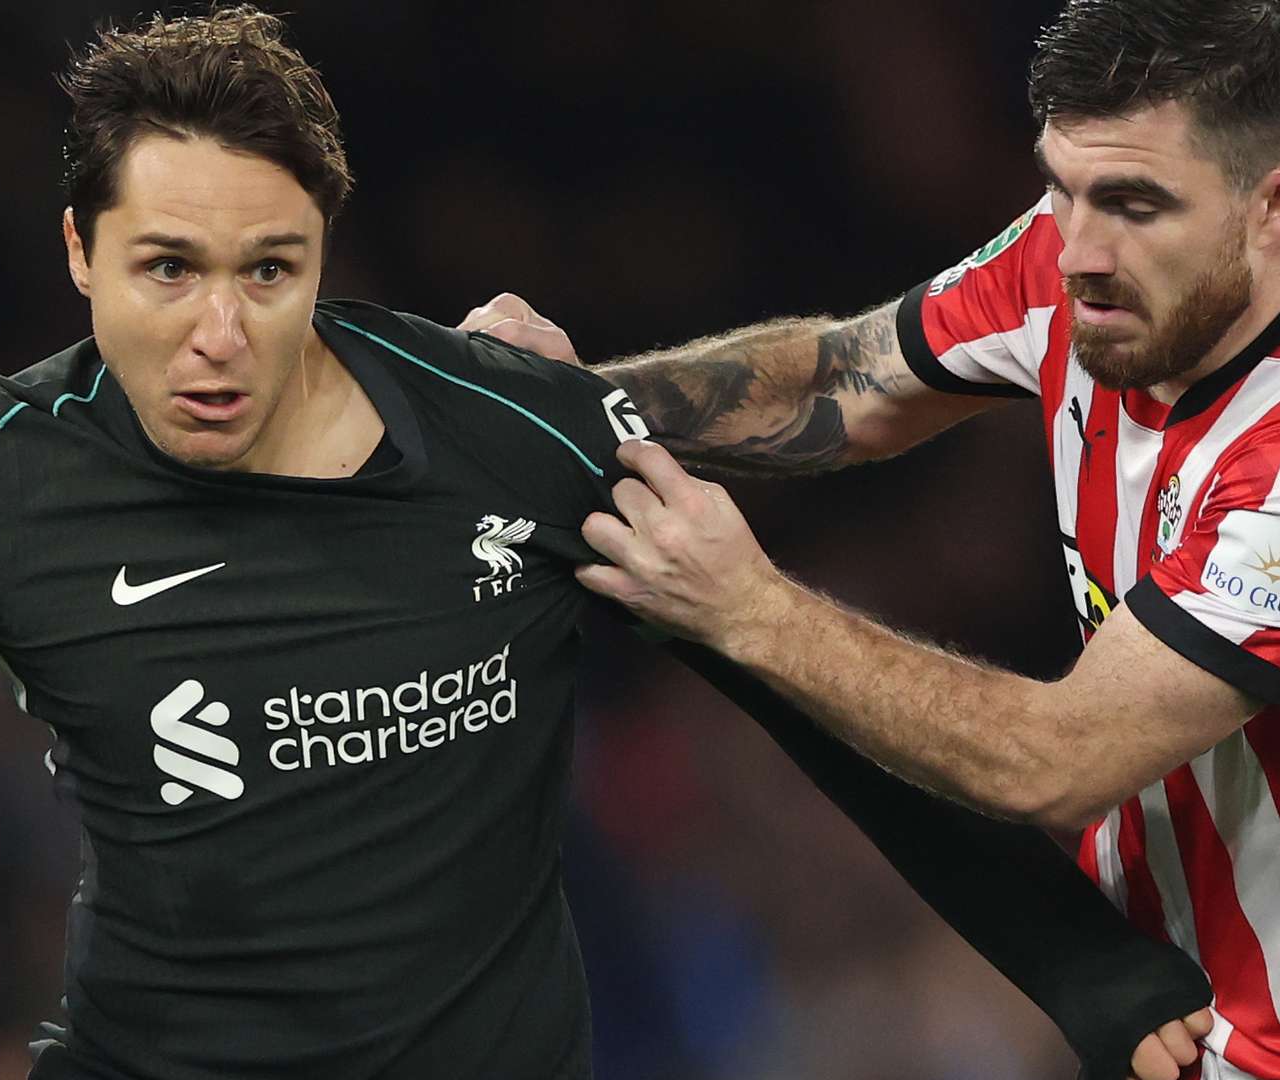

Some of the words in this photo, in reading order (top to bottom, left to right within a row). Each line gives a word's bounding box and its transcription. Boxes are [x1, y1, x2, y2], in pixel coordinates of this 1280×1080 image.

[1206, 562, 1244, 597] P&O
[263, 642, 511, 731] standard
[269, 679, 517, 771] chartered
